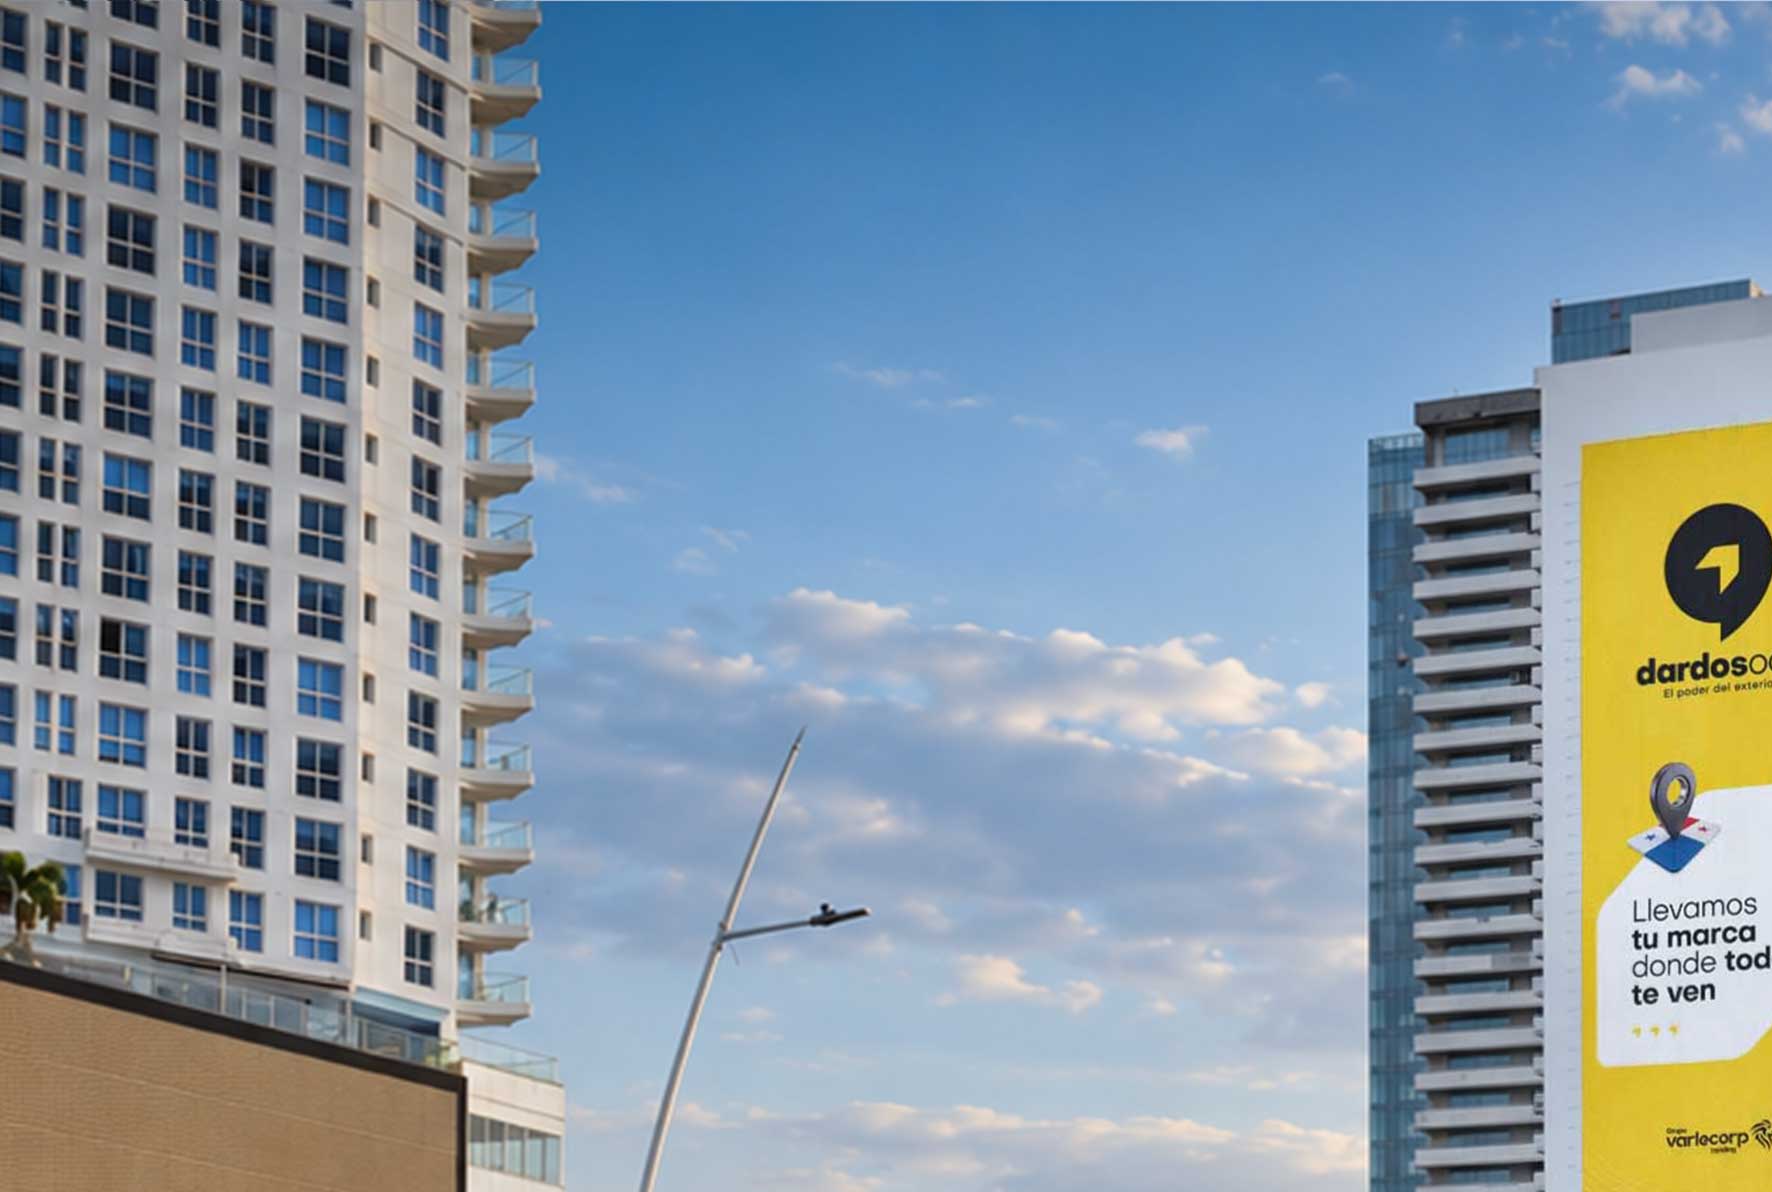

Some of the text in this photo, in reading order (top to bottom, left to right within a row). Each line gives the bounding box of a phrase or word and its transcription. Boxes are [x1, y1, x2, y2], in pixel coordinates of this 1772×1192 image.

[1664, 689, 1674, 699] El
[1677, 687, 1710, 699] poder
[1713, 683, 1731, 693] del
[1634, 897, 1758, 923] Llevamos
[1632, 925, 1756, 950] tu marca
[1632, 950, 1717, 978] donde
[1632, 983, 1716, 1006] te ven
